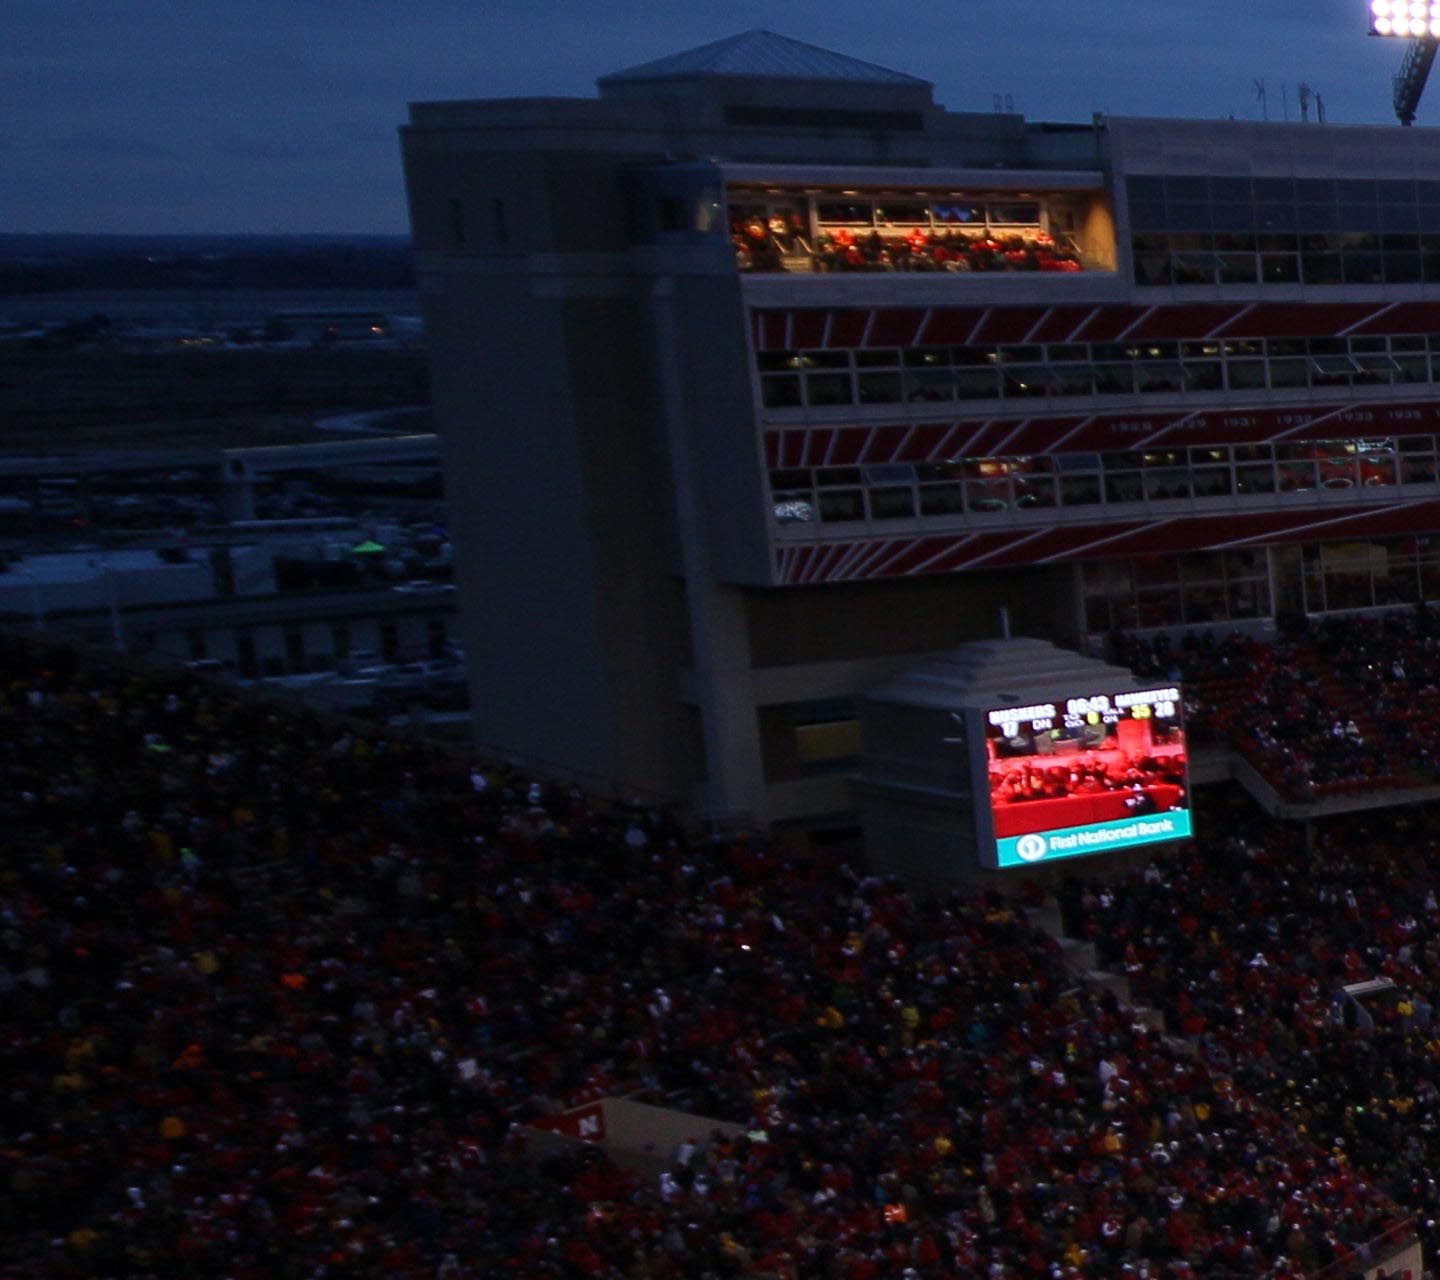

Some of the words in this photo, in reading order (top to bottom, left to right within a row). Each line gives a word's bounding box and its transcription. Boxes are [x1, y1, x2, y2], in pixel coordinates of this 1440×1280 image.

[1050, 834, 1078, 850] First
[1078, 824, 1137, 846] National
[1138, 819, 1174, 836] Bank
